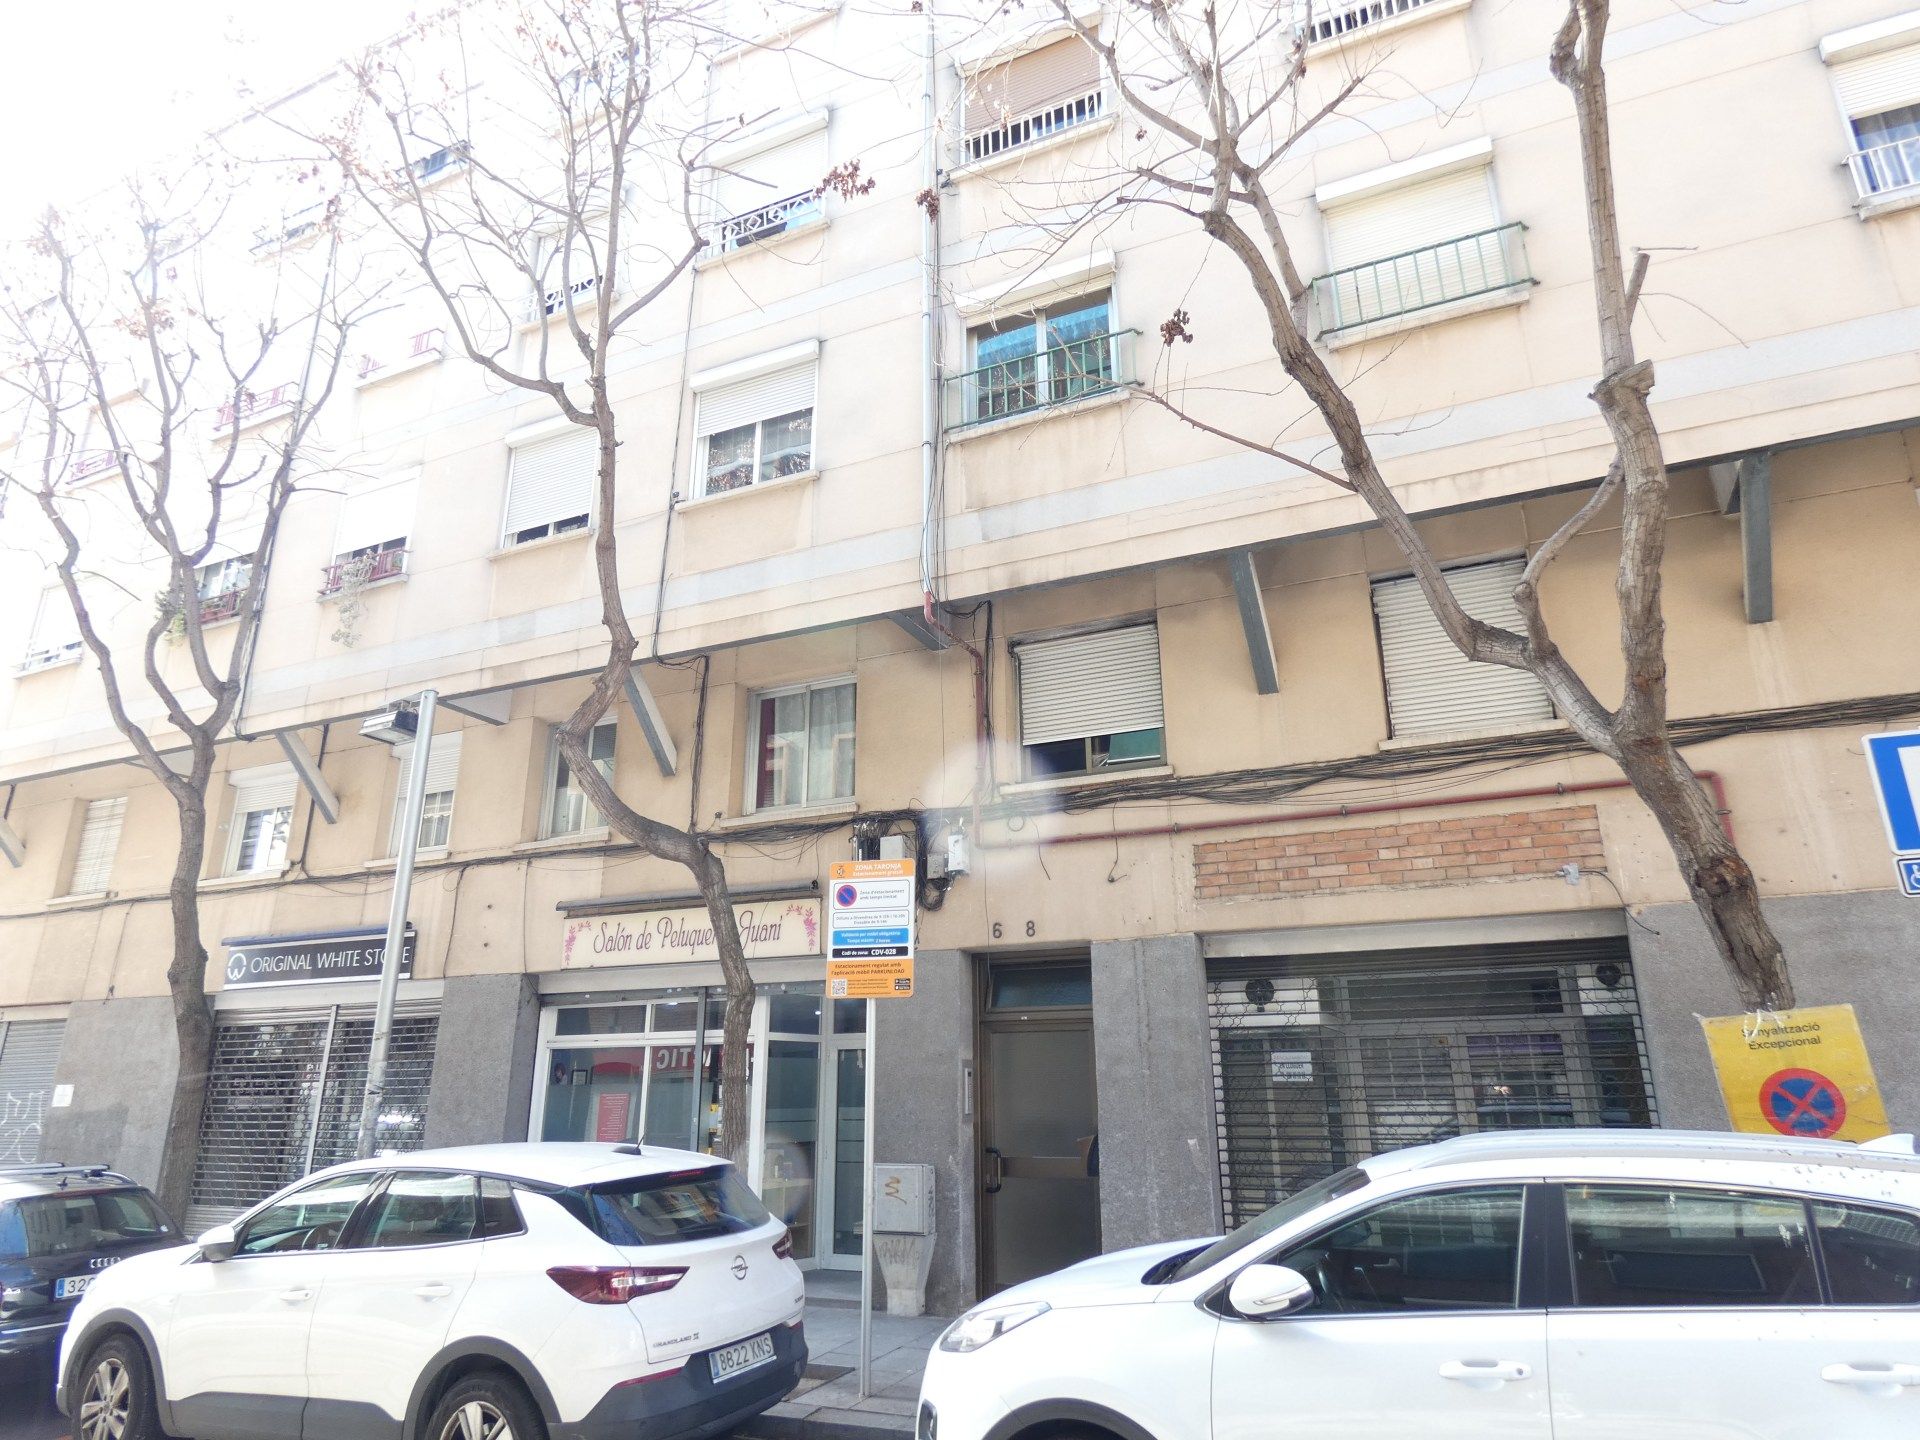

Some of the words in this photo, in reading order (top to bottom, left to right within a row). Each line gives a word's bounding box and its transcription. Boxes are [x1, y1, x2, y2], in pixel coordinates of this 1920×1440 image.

[594, 921, 632, 954] Salón
[636, 924, 652, 950] de
[657, 916, 718, 956] Peluquer
[739, 910, 784, 950] Juani
[251, 954, 312, 973] ORIGINAL
[317, 950, 361, 968] WHITE
[365, 946, 410, 966] STOE
[1749, 1035, 1821, 1050] Excepcional
[750, 1338, 772, 1360] KNS
